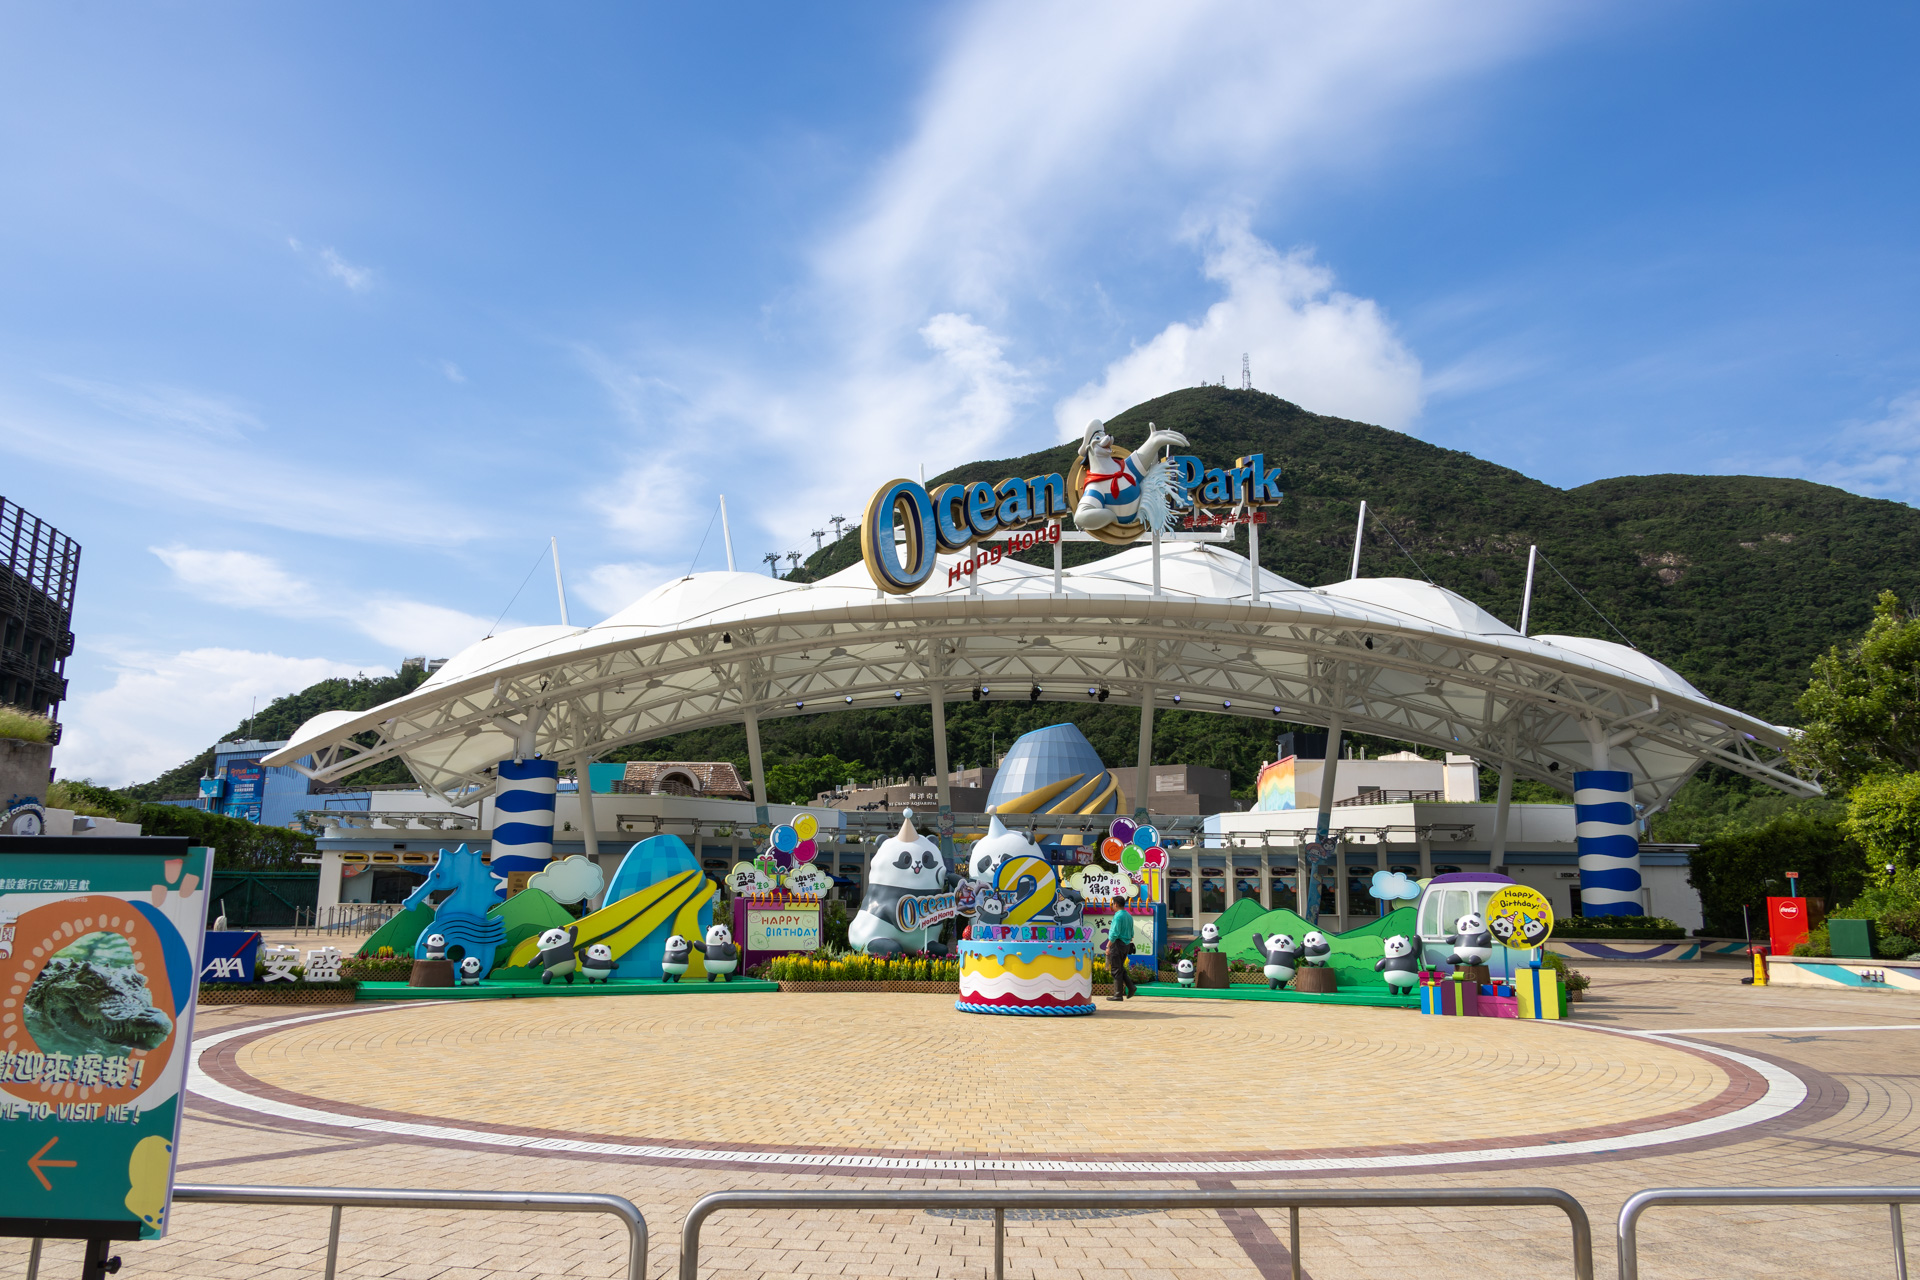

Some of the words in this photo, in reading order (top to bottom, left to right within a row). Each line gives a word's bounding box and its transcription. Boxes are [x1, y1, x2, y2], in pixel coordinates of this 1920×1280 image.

[861, 472, 1067, 594] Ocean
[1166, 453, 1284, 513] Park
[1182, 512, 1267, 529] 香港海洋公園
[948, 539, 1002, 588] Hong
[1007, 523, 1061, 556] Kong
[1083, 873, 1109, 884] 加加
[1089, 883, 1110, 896] 得得
[1504, 890, 1534, 899] Happy
[898, 894, 955, 931] Ocean
[1500, 900, 1540, 910] Birthday!
[761, 916, 800, 925] HAPPY
[921, 915, 938, 928] Hong
[938, 910, 954, 921] Kong
[766, 927, 818, 937] BIRTHDAY
[972, 925, 1020, 940] HAPPY
[1021, 926, 1093, 940] BIRTHDAY
[200, 957, 245, 978] AXA
[261, 945, 343, 982] 安盛
[27, 1101, 51, 1121] TO
[57, 1102, 102, 1122] VISIT
